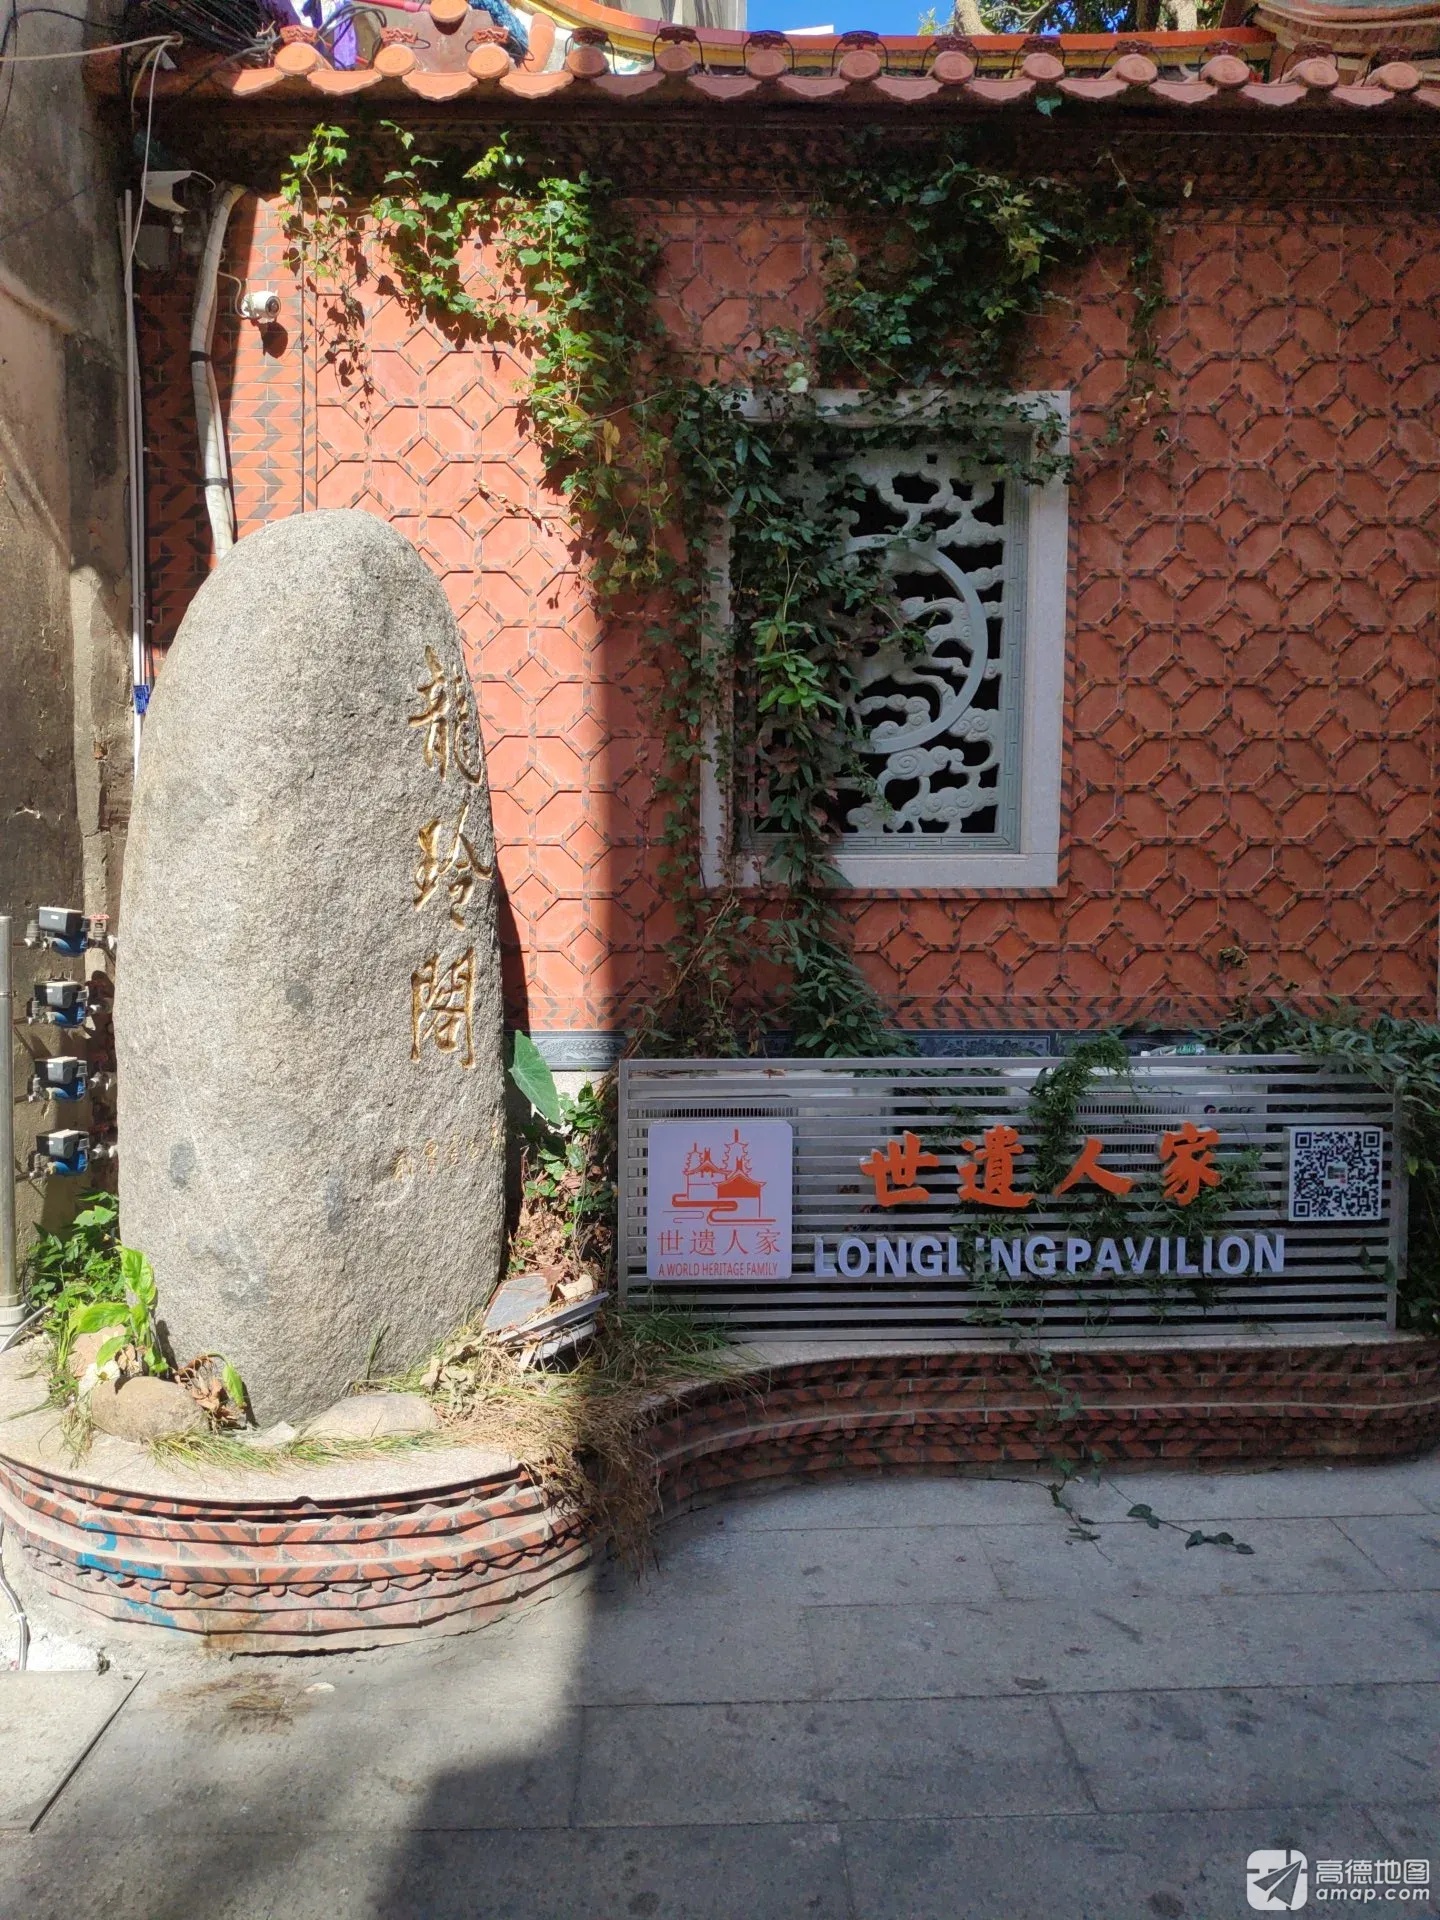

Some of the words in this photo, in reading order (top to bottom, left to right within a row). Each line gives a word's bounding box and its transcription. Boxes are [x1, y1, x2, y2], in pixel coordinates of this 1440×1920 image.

[858, 1120, 1222, 1209] 世遺人家
[656, 1228, 781, 1256] 世遗人家
[658, 1263, 665, 1277] A
[667, 1263, 700, 1277] WORLD
[702, 1262, 744, 1276] HERITAGE
[746, 1261, 778, 1276] FAMILY
